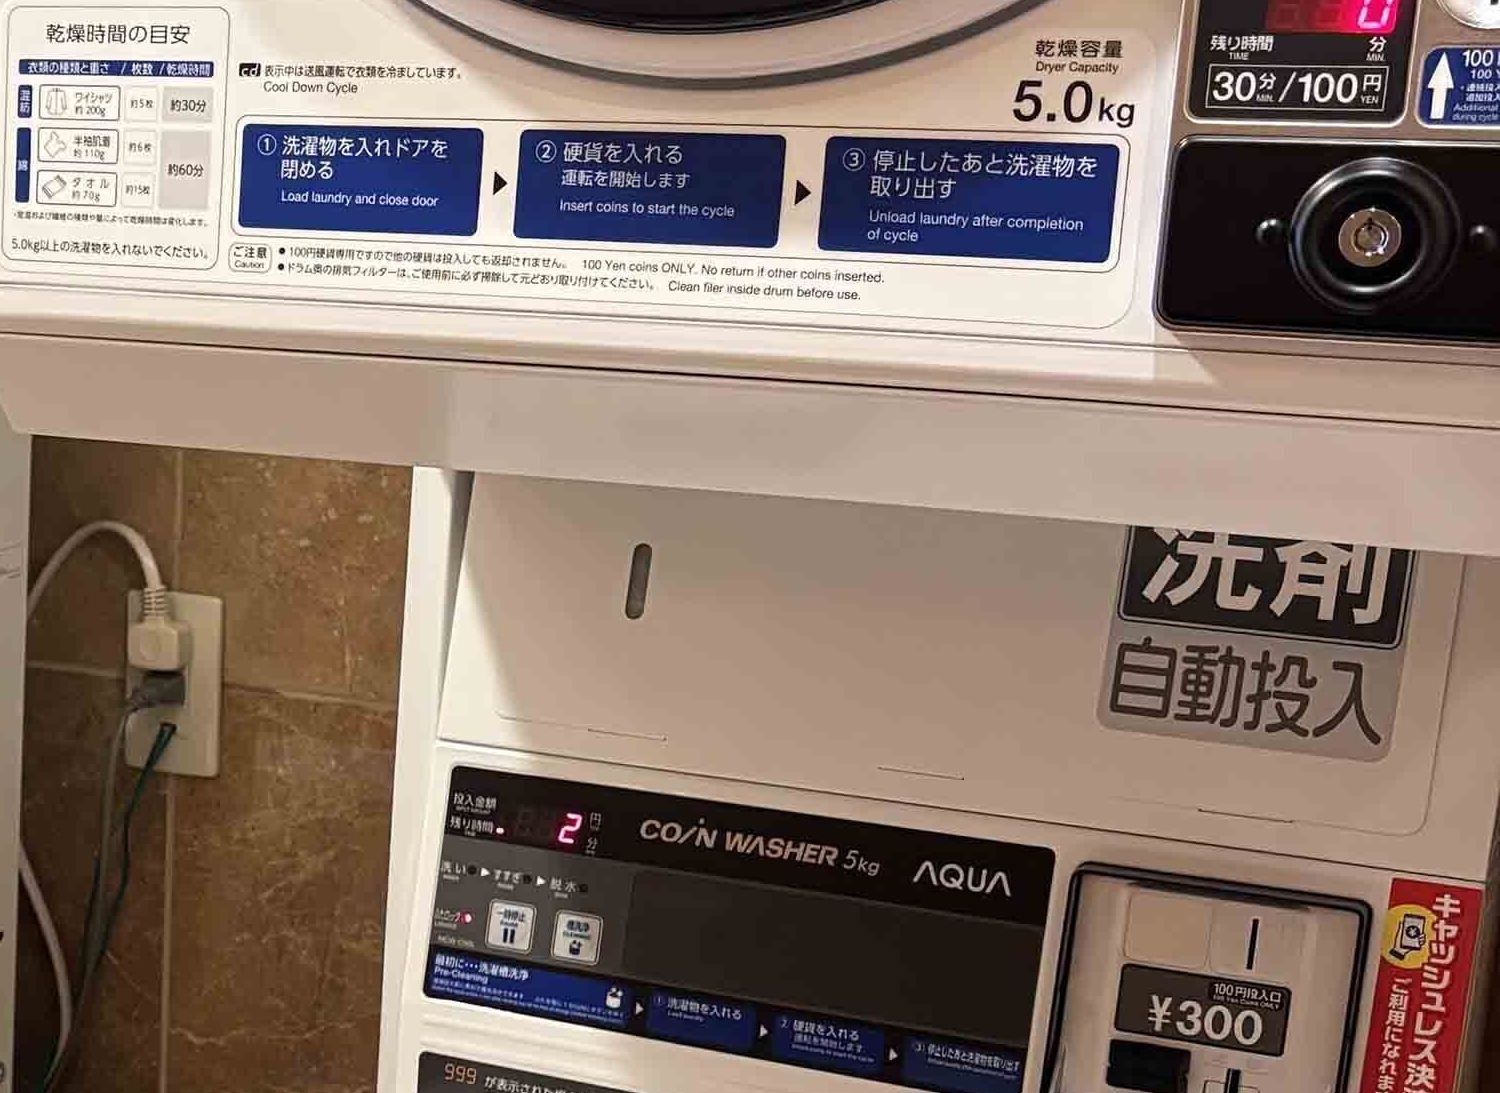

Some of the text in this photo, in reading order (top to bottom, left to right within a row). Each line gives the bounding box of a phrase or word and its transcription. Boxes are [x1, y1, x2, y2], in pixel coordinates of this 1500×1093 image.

[46, 23, 190, 45] 乾燥時間の目安
[1210, 34, 1387, 52] 残り時間 分
[1035, 39, 1124, 58] 乾燥容量
[1229, 52, 1249, 61] TIME
[27, 62, 211, 77] 衣類の種類と重さ 枚数 乾燥時間
[264, 65, 461, 80] 表示中は送風運転で衣類を冷ましています。
[1035, 61, 1119, 75] Dryer Capacity
[75, 92, 113, 105] ワイシャツ
[263, 81, 358, 97] Cool Down Cycle
[170, 100, 207, 114] 約30分
[1360, 94, 1379, 105] YEN
[282, 135, 448, 158] 洗濯物を入れドアを
[563, 142, 683, 165] 硬貨を入れる
[167, 164, 204, 177] 約60分
[280, 160, 333, 180] 閉める
[873, 149, 1098, 179] 停止したあと洗濯物を
[561, 169, 691, 189] 運転を開始します
[869, 175, 957, 200] 取り出す
[281, 191, 439, 207] Load laundry and close door
[560, 199, 735, 220] Insert coins to start the cycle
[869, 209, 1084, 233] Unload laundry after completion
[867, 228, 919, 245] of cycle
[11, 237, 209, 259] 5.0kg以上の洗濯物を入れないでください。
[232, 246, 269, 259] ご注意
[234, 259, 266, 270] Caution
[582, 259, 602, 271] 100
[605, 260, 627, 273] Yen
[629, 261, 658, 274] coins
[661, 262, 698, 276] ONLY.
[701, 264, 718, 276] No
[720, 266, 754, 278] return
[757, 266, 764, 278] if
[767, 267, 798, 280] other
[800, 269, 831, 281] coins
[834, 269, 885, 284] inserted.
[668, 280, 700, 293] Clean
[727, 283, 760, 296] inside
[763, 285, 794, 297] drum
[797, 286, 834, 299] before
[837, 289, 862, 301] use.
[1110, 636, 1382, 746] 自動投入
[453, 792, 498, 810] 投入金額
[450, 816, 494, 834] 残り時間
[558, 812, 583, 845] 2
[723, 830, 840, 866] WASHER
[843, 849, 880, 877] 5kg
[912, 859, 1013, 898] AQUA
[550, 877, 578, 894] 脱水
[434, 965, 489, 986] Pre-Cleaning
[1214, 983, 1282, 1003] 100円投入口
[1403, 894, 1461, 1093] キャッシュレス決
[667, 996, 742, 1021] 洗濯物を入れる
[1147, 994, 1263, 1045] ¥300
[1374, 977, 1413, 1093] ご利用になれま
[444, 1063, 477, 1085] 999
